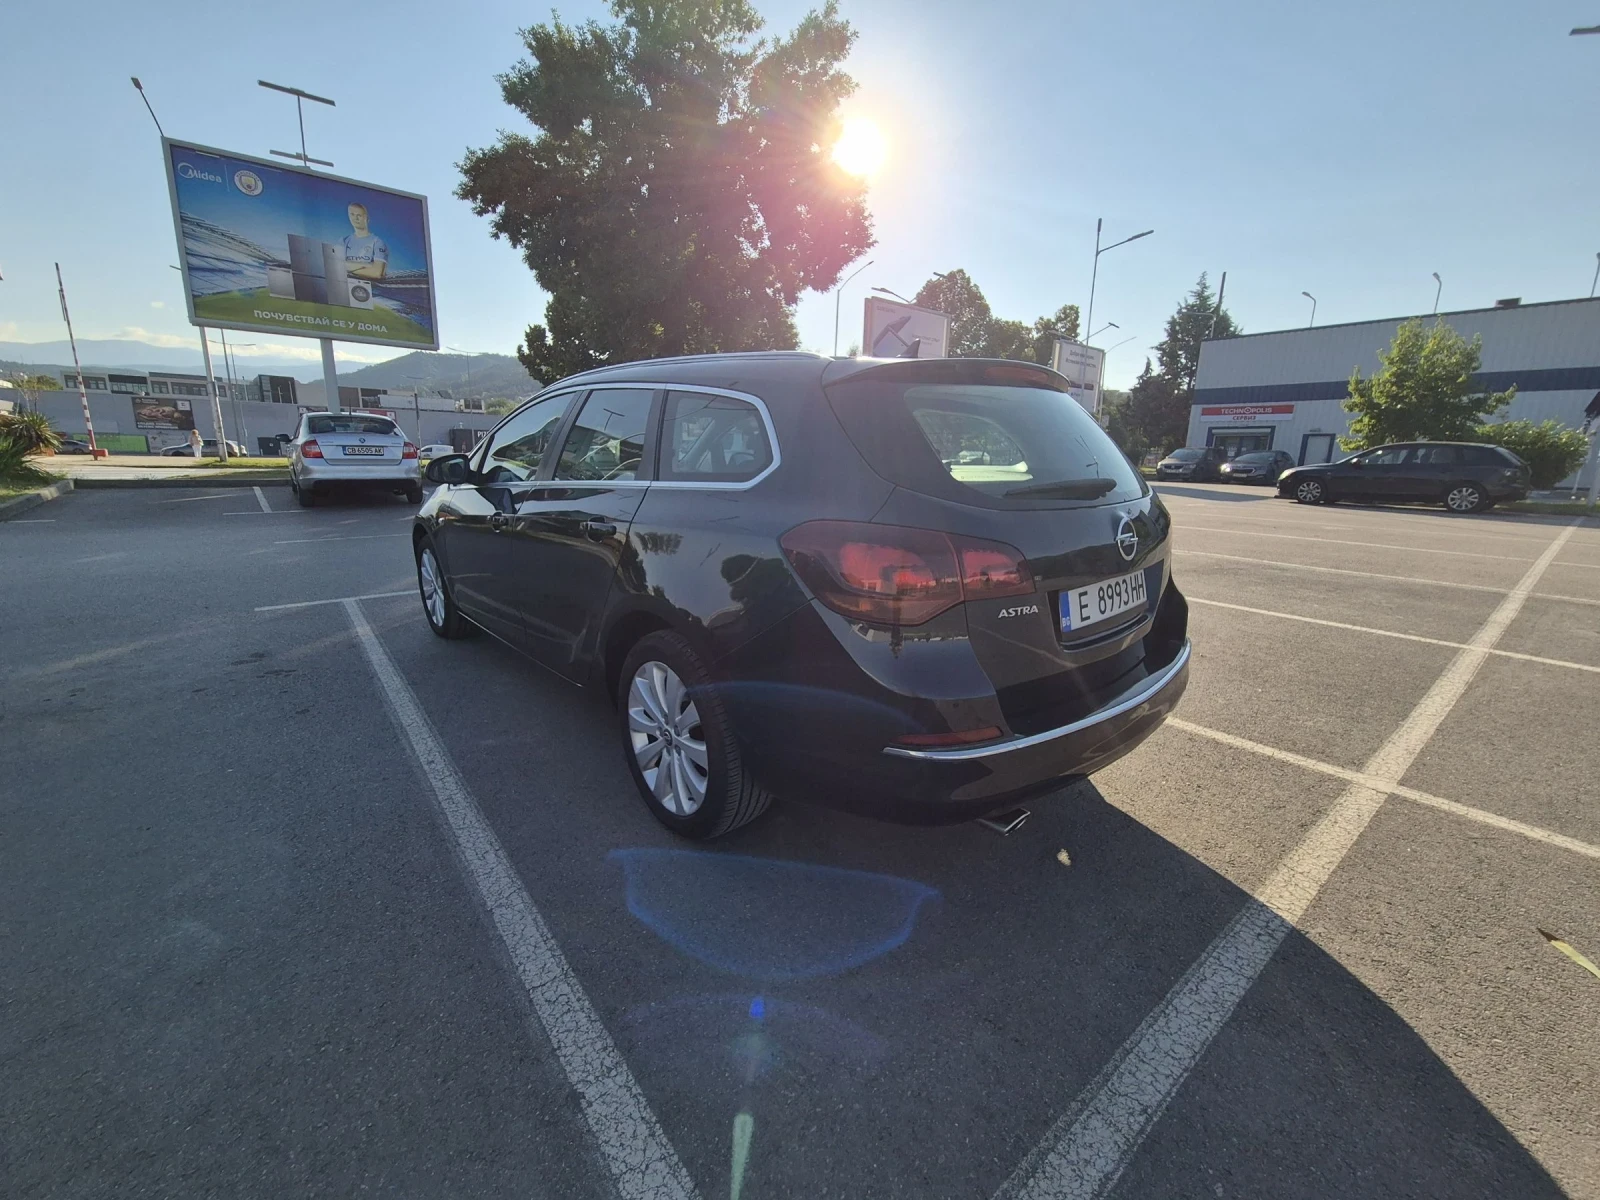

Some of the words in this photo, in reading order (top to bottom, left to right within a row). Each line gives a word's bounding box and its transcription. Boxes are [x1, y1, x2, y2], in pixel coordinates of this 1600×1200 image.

[181, 164, 222, 183] Midea
[254, 310, 330, 326] ПОЧУВСТВАЙ
[332, 319, 346, 327] СЕ
[348, 321, 355, 329] У
[357, 322, 388, 333] ДОМА
[1221, 406, 1272, 414] TECHNOPOLIS
[998, 605, 1039, 619] ASTRA
[1078, 591, 1091, 623] E
